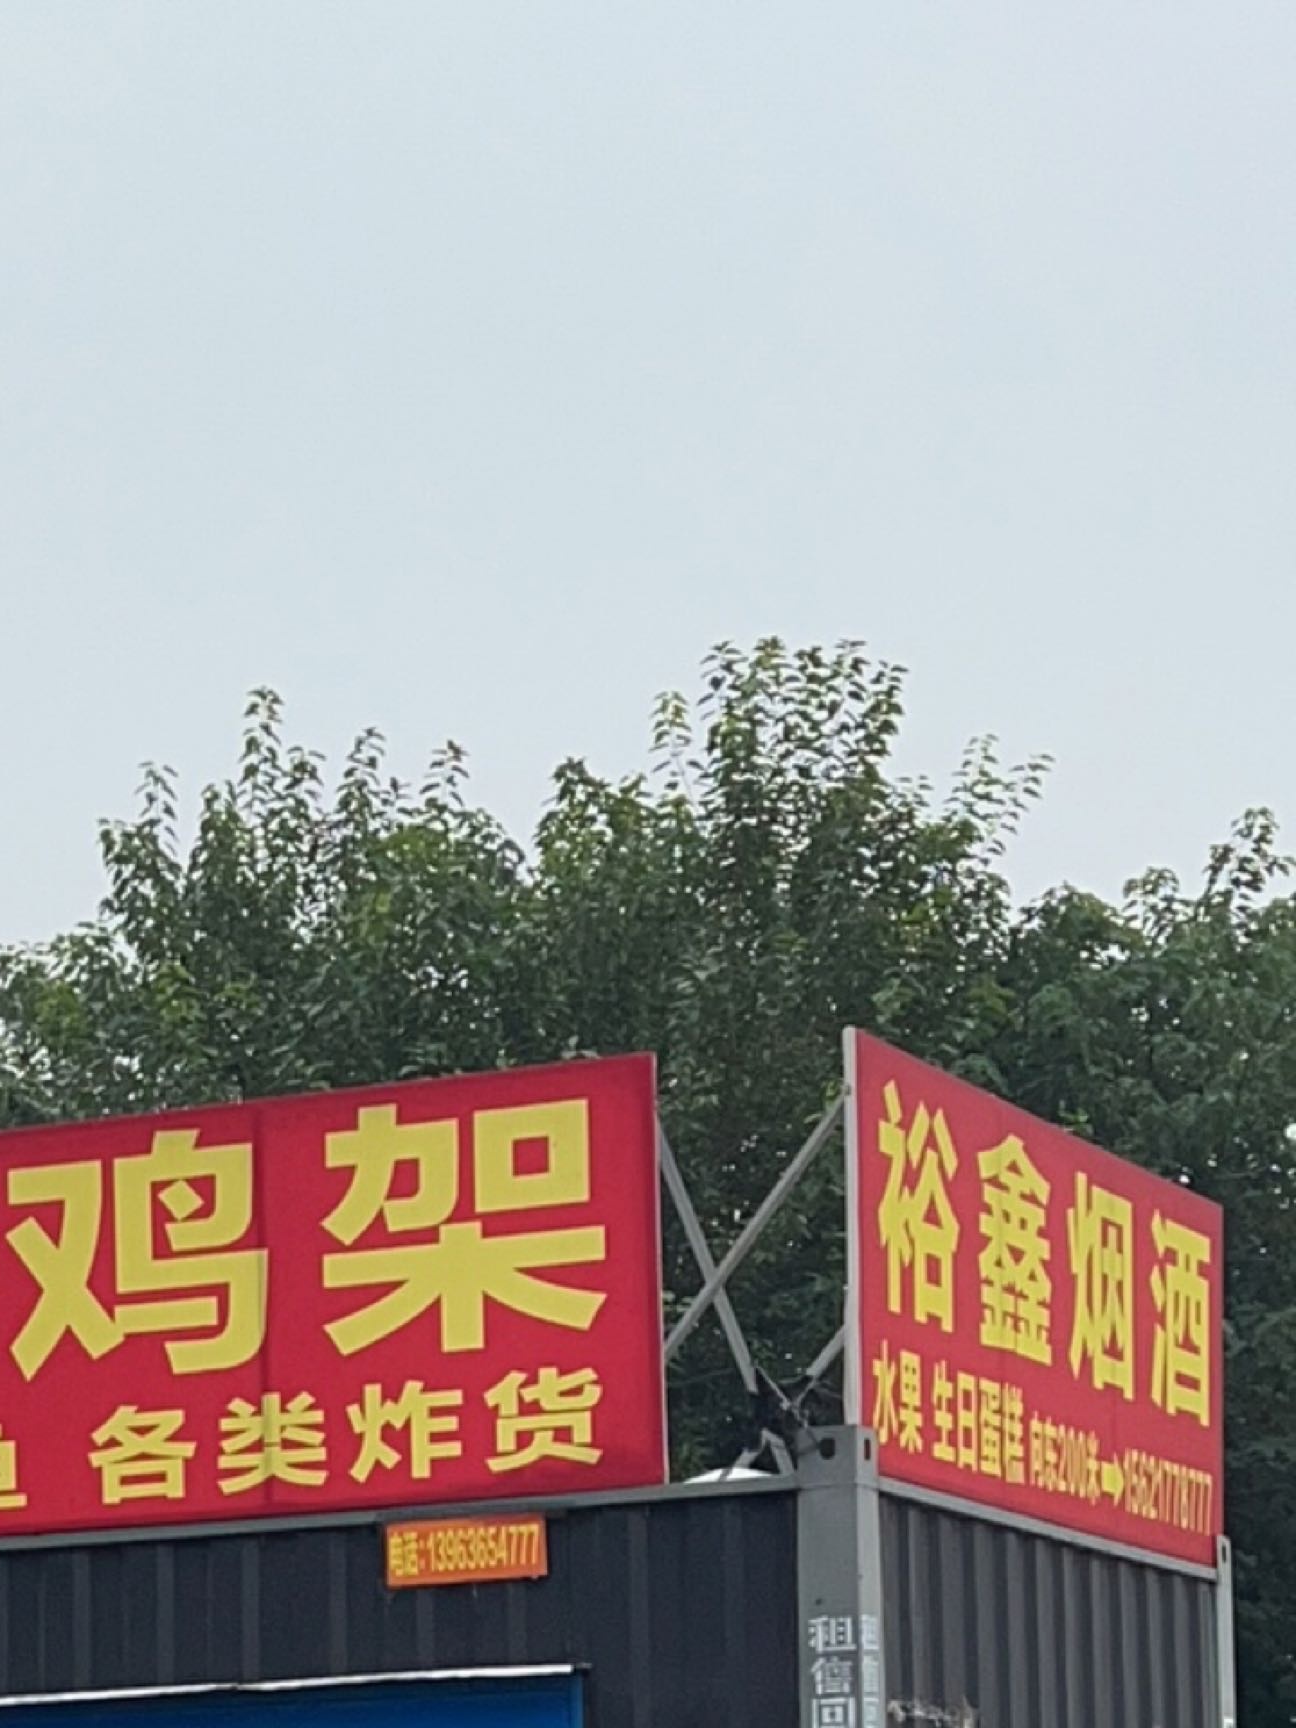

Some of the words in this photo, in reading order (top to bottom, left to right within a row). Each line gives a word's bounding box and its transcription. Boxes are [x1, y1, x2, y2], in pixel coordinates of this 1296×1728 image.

[878, 1079, 1211, 1427] 裕鑫烟酒
[89, 1366, 604, 1505] 各类炸货
[872, 1339, 923, 1454] 水果
[932, 1359, 1025, 1485] 生日蛋糕
